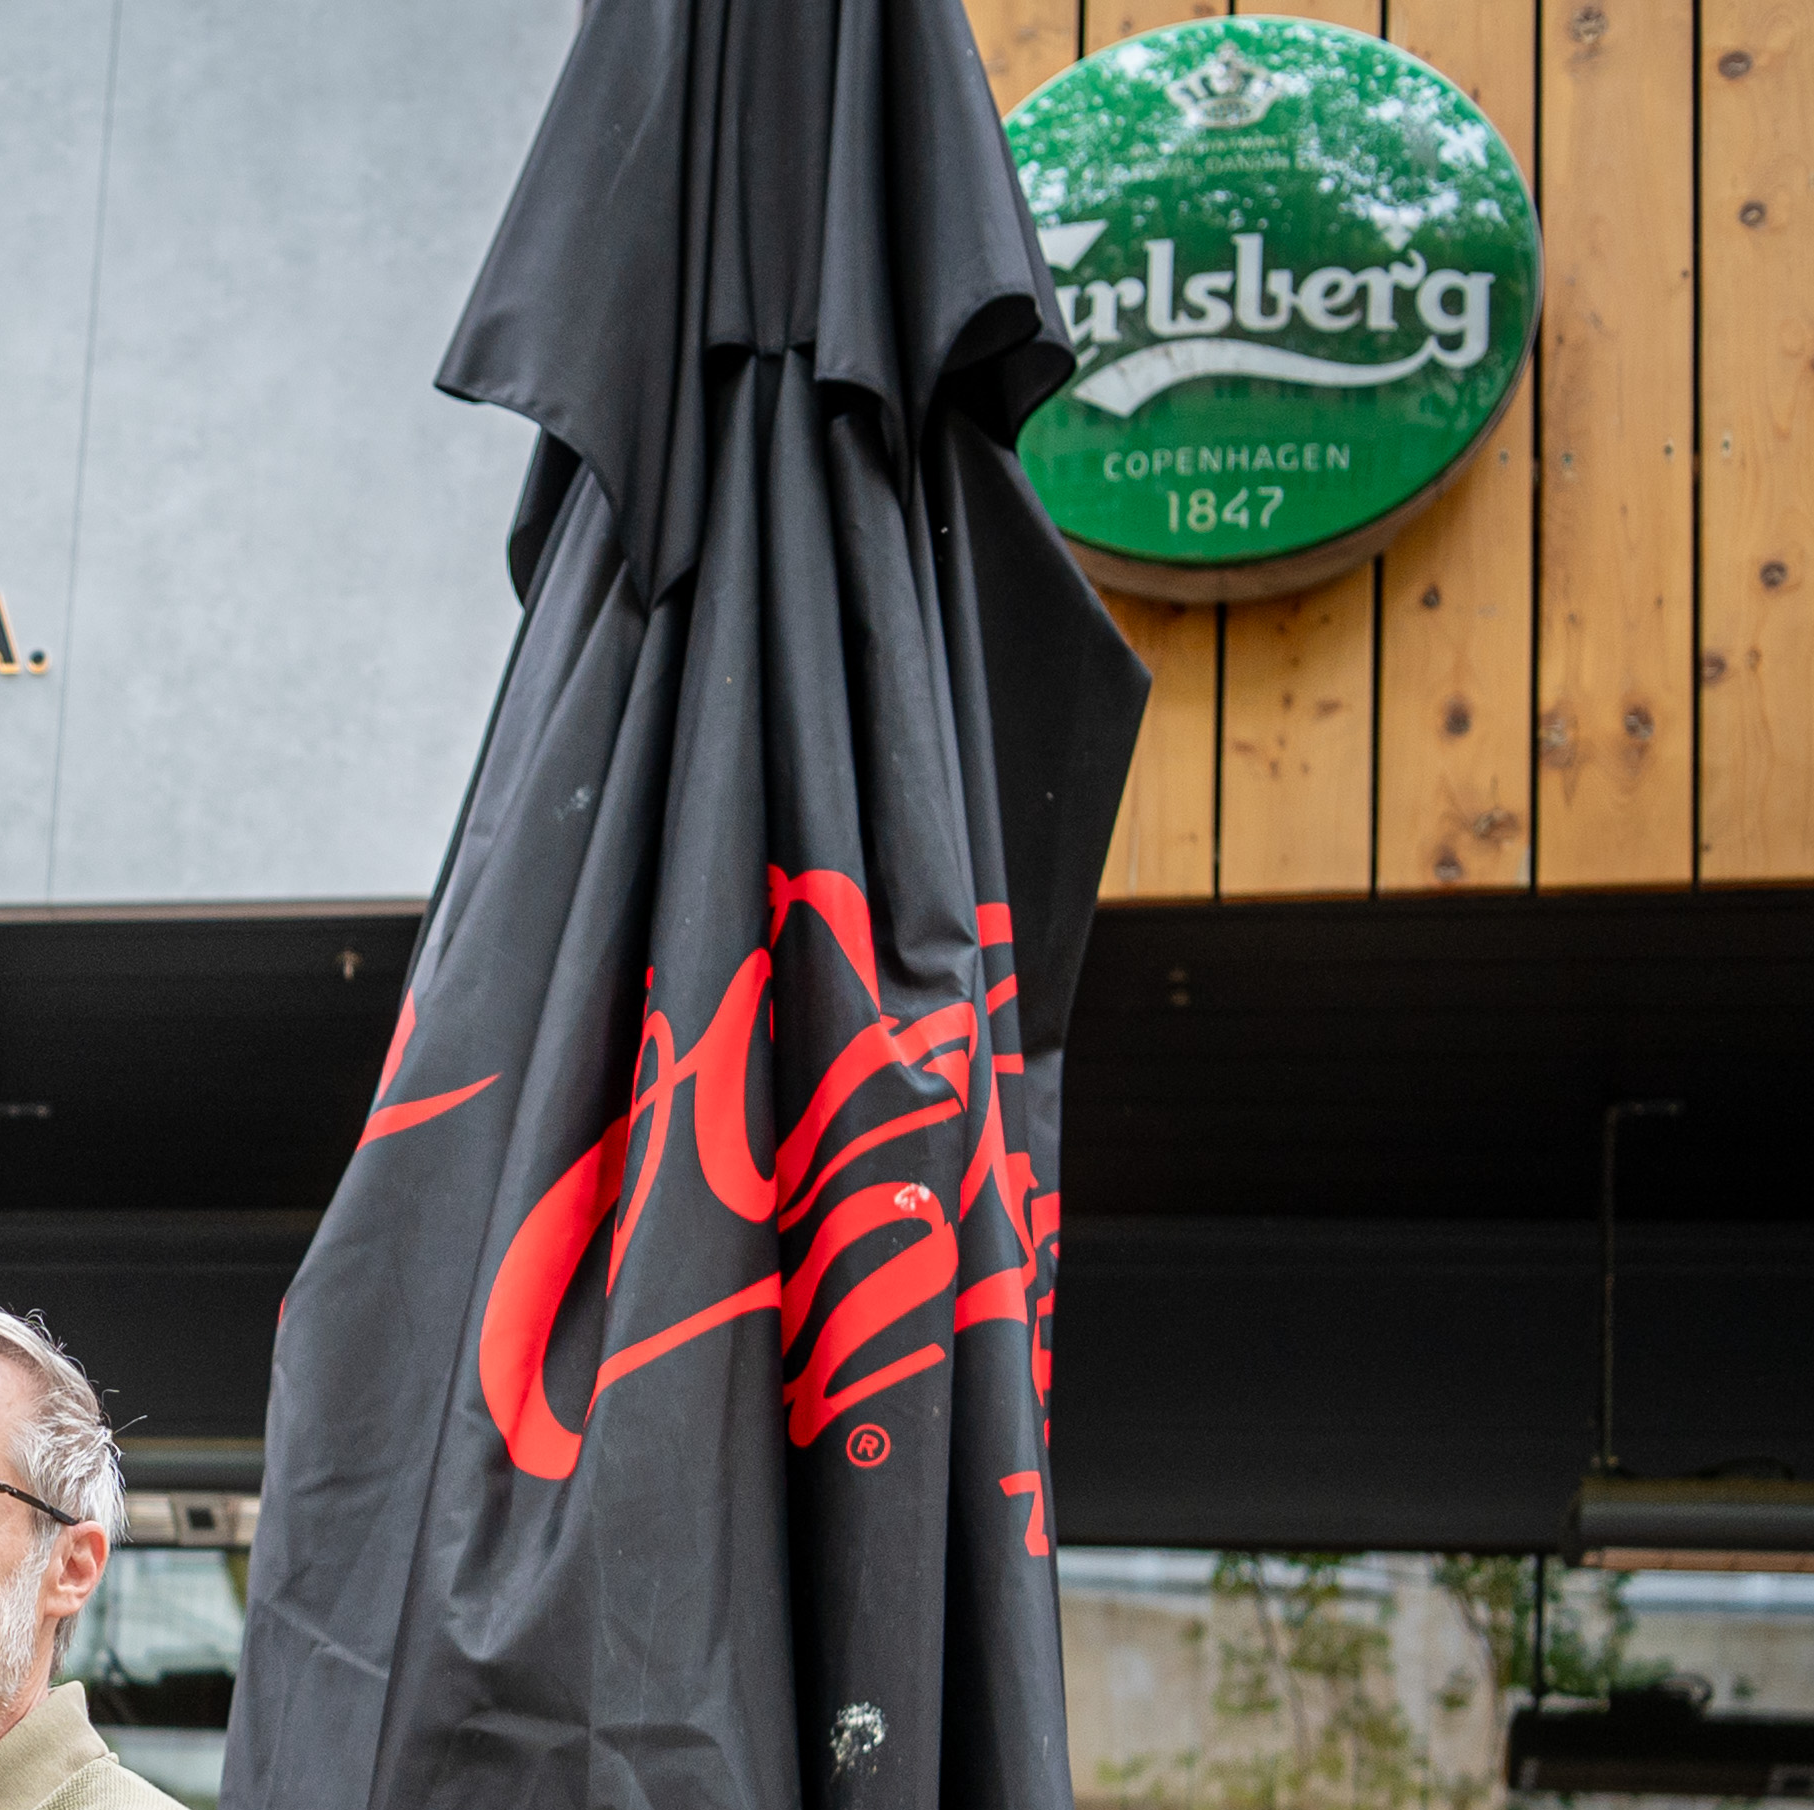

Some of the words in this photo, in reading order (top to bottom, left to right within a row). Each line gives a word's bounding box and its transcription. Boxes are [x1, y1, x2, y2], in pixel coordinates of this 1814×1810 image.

[1037, 219, 1496, 370] arlsberg
[1103, 441, 1352, 482] COPENHAGEN
[1167, 485, 1285, 533] 1847
